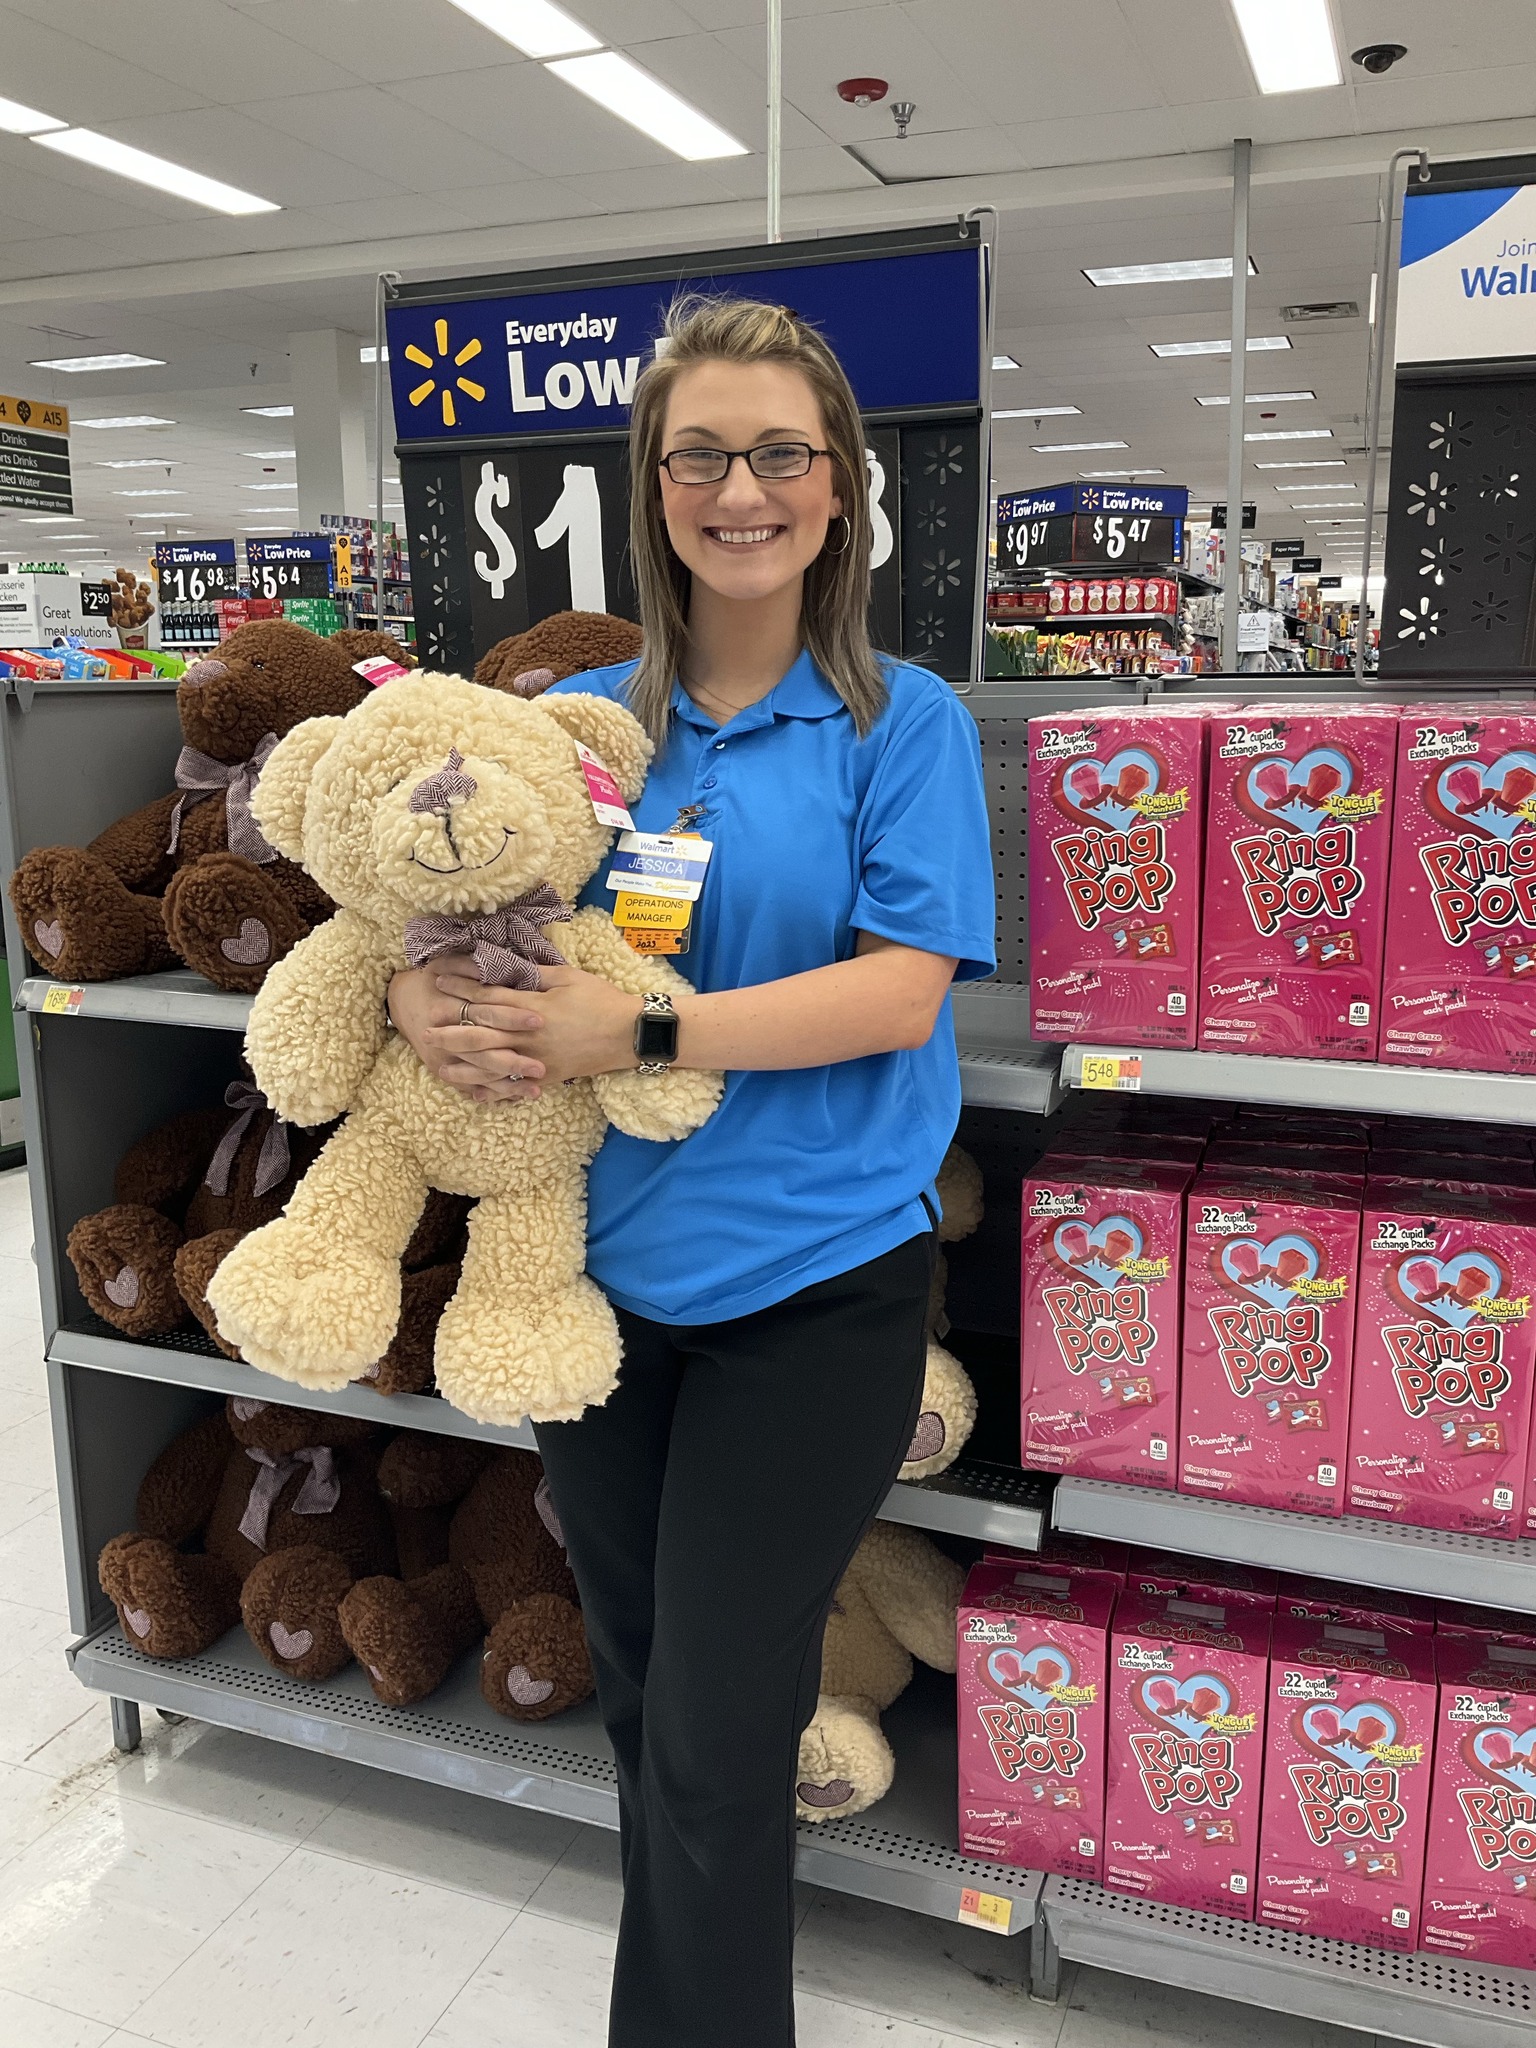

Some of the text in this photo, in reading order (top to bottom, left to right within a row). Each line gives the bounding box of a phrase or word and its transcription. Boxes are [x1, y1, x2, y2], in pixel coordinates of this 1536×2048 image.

[506, 312, 618, 348] Everyday
[508, 351, 640, 412] Low
[43, 411, 62, 426] A15
[2, 433, 27, 446] Drinks
[13, 454, 38, 468] Drinks
[17, 475, 40, 487] Water
[1013, 500, 1056, 518] Low Price
[1103, 498, 1163, 511] Low Price
[173, 553, 217, 562] Low Price
[265, 549, 311, 559] Low Price
[340, 578, 349, 586] 13
[43, 606, 71, 619] Great
[44, 626, 67, 637] meal
[70, 627, 112, 638] solutions
[1042, 730, 1060, 747] 22
[1227, 728, 1245, 745] 22
[1417, 729, 1436, 747] 22
[1038, 743, 1095, 759] Exchange Packs
[1221, 741, 1284, 757] Exchange Packs
[1410, 743, 1477, 759] Exchange Packs
[1141, 794, 1181, 808] TONGUE
[1332, 795, 1374, 808] TONGUE
[640, 842, 675, 854] Walmart
[1054, 826, 1162, 880] Ring
[1234, 827, 1353, 883] Ring
[629, 857, 683, 875] JESSICA
[1423, 837, 1536, 891] Ring
[626, 899, 683, 909] OPERATIONS
[627, 913, 672, 922] MANAGER
[1208, 978, 1261, 998] Personalize
[1171, 996, 1182, 1005] 40
[1391, 990, 1448, 1009] Personalize
[1353, 1005, 1365, 1015] 40
[1204, 1018, 1231, 1028] Cherry
[1204, 1032, 1247, 1041] Strawberry
[1036, 1191, 1051, 1205] 22
[1031, 1206, 1084, 1216] Exchange Packs
[1203, 1208, 1220, 1223] 22
[1198, 1224, 1255, 1234] Exchange Packs
[1379, 1224, 1397, 1239] 22
[1373, 1239, 1434, 1250] Exchange Packs
[1126, 1259, 1162, 1271] TONGUE
[1300, 1279, 1340, 1291] TONGUE
[1044, 1284, 1145, 1326] Ring
[1481, 1298, 1523, 1311] TONGUE
[1211, 1304, 1320, 1350] Ring
[1384, 1322, 1501, 1371] Ring
[1321, 1468, 1332, 1476] 40
[1497, 1492, 1508, 1500] 40
[970, 1619, 984, 1632] 22
[965, 1634, 1015, 1642] Exchange Packs
[1124, 1645, 1139, 1659] 22
[1119, 1659, 1172, 1670] Exchange Packs
[1285, 1673, 1301, 1687] 22
[1279, 1688, 1335, 1698] Exchange Packs
[1456, 1697, 1473, 1711] 22
[980, 1703, 1074, 1743] Ring
[1450, 1712, 1509, 1721] Exchange Packs
[1131, 1733, 1232, 1773] Ring
[1291, 1764, 1396, 1804] Ring
[1459, 1787, 1536, 1829] Rin
